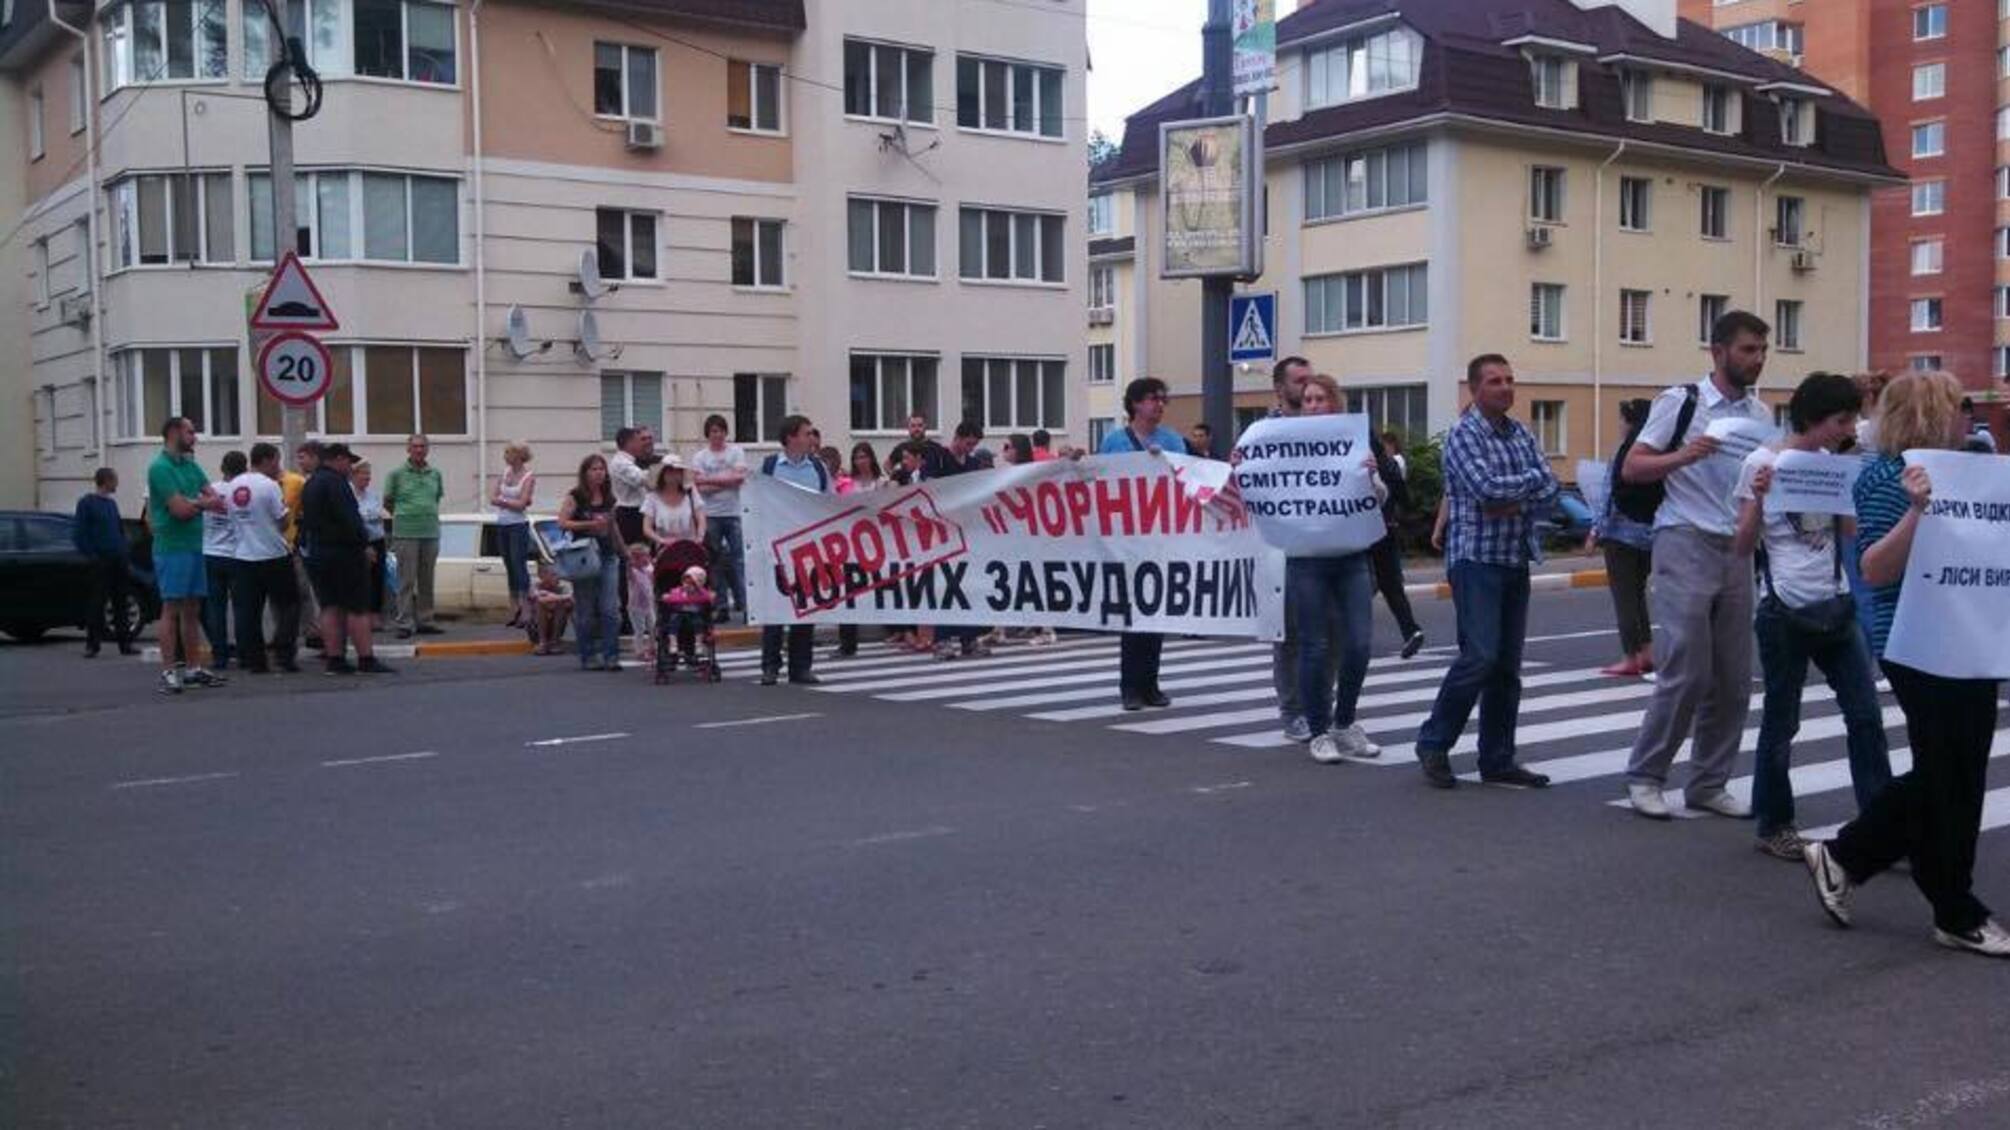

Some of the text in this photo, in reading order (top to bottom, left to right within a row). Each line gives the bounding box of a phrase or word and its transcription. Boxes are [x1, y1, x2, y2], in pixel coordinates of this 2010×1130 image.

[277, 355, 315, 382] 20
[1238, 469, 1342, 489] СМІТТЄВУ
[789, 506, 949, 598] ПРОТИ
[774, 561, 971, 610] ЧОРНИХ
[1939, 566, 1981, 587] ЛІСИ
